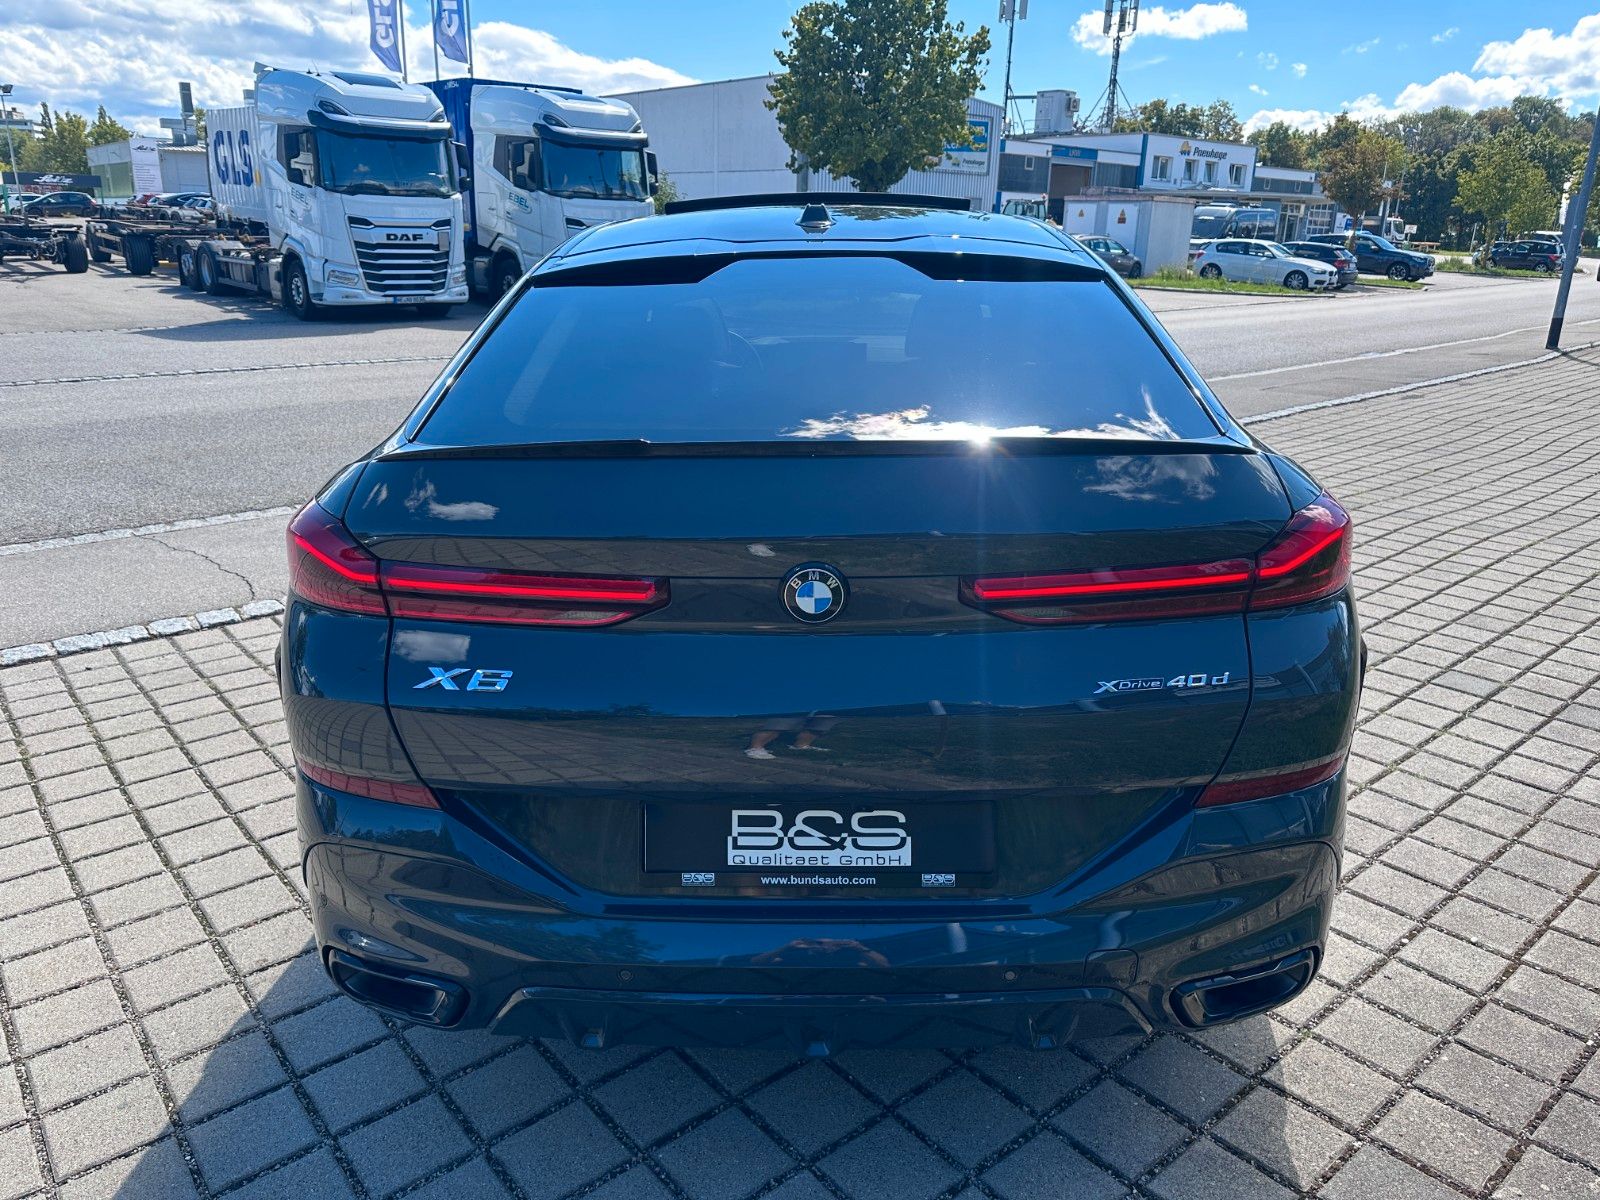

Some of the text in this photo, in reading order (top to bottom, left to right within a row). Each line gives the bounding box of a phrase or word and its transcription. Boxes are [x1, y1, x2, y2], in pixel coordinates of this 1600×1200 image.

[214, 129, 254, 187] GLS
[1193, 146, 1228, 161] Pneuhage
[291, 187, 309, 205] EBEL
[508, 192, 530, 209] EBEL
[386, 233, 424, 242] DAF
[790, 571, 839, 590] BMW
[412, 666, 514, 693] X6
[731, 809, 908, 852] B&S
[732, 853, 831, 866] Qualitaet
[682, 872, 955, 886] B&S www.bundsauto.com B&S
